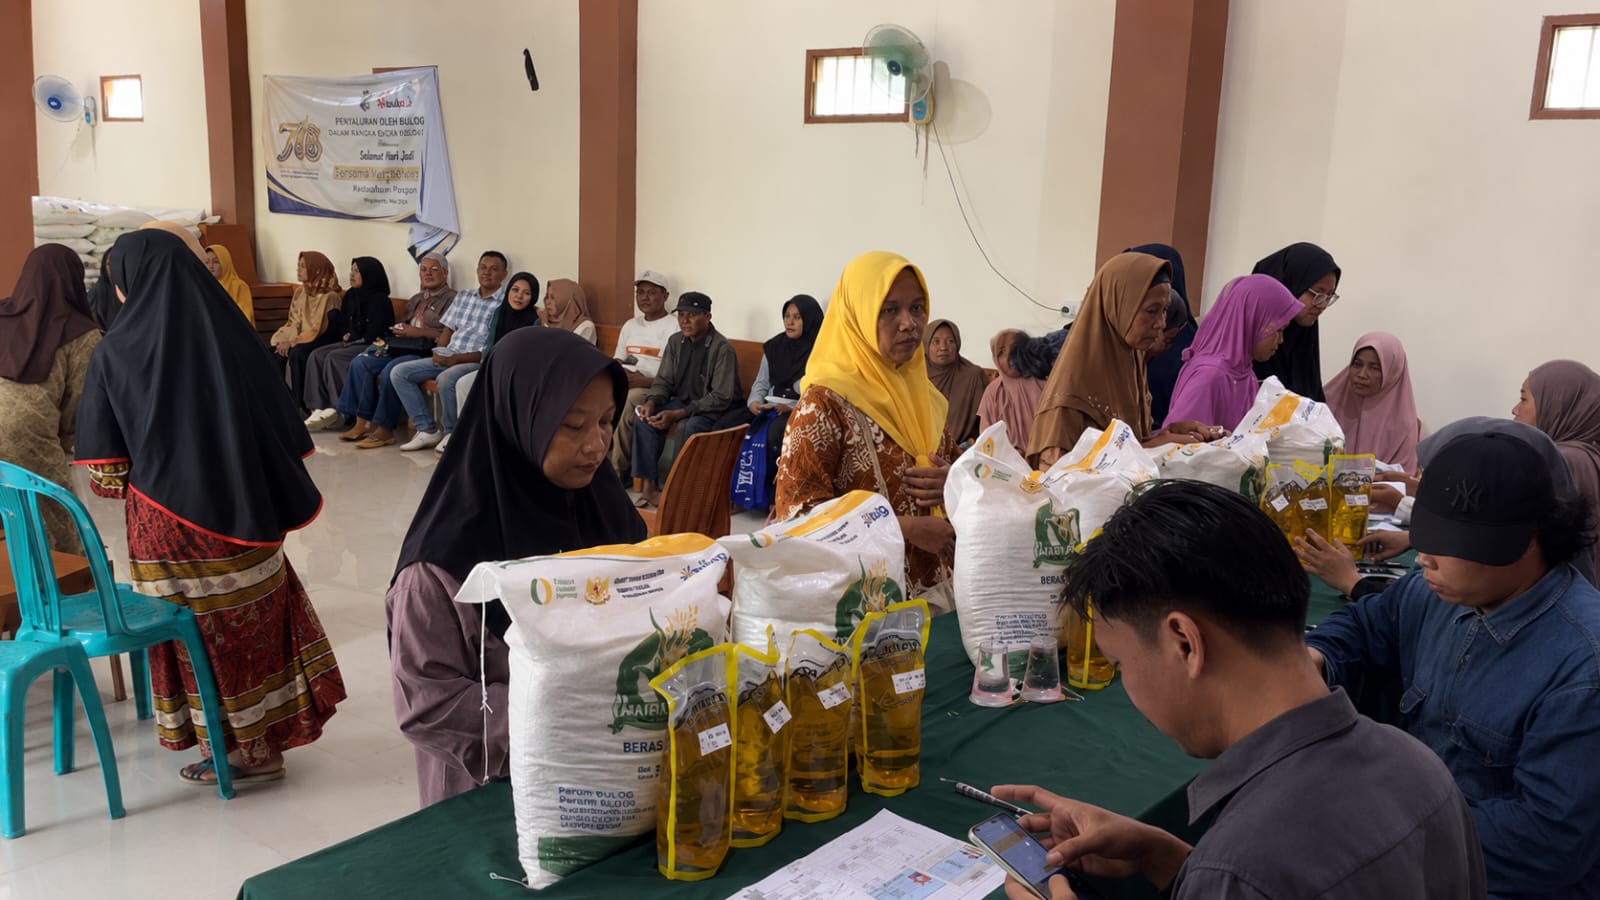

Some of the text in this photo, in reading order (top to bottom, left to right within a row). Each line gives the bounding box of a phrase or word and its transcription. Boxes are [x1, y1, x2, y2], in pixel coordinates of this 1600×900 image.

[335, 116, 425, 126] PENYALURAN OLEH BULOG
[385, 150, 399, 161] Hari
[623, 740, 663, 753] BERAS
